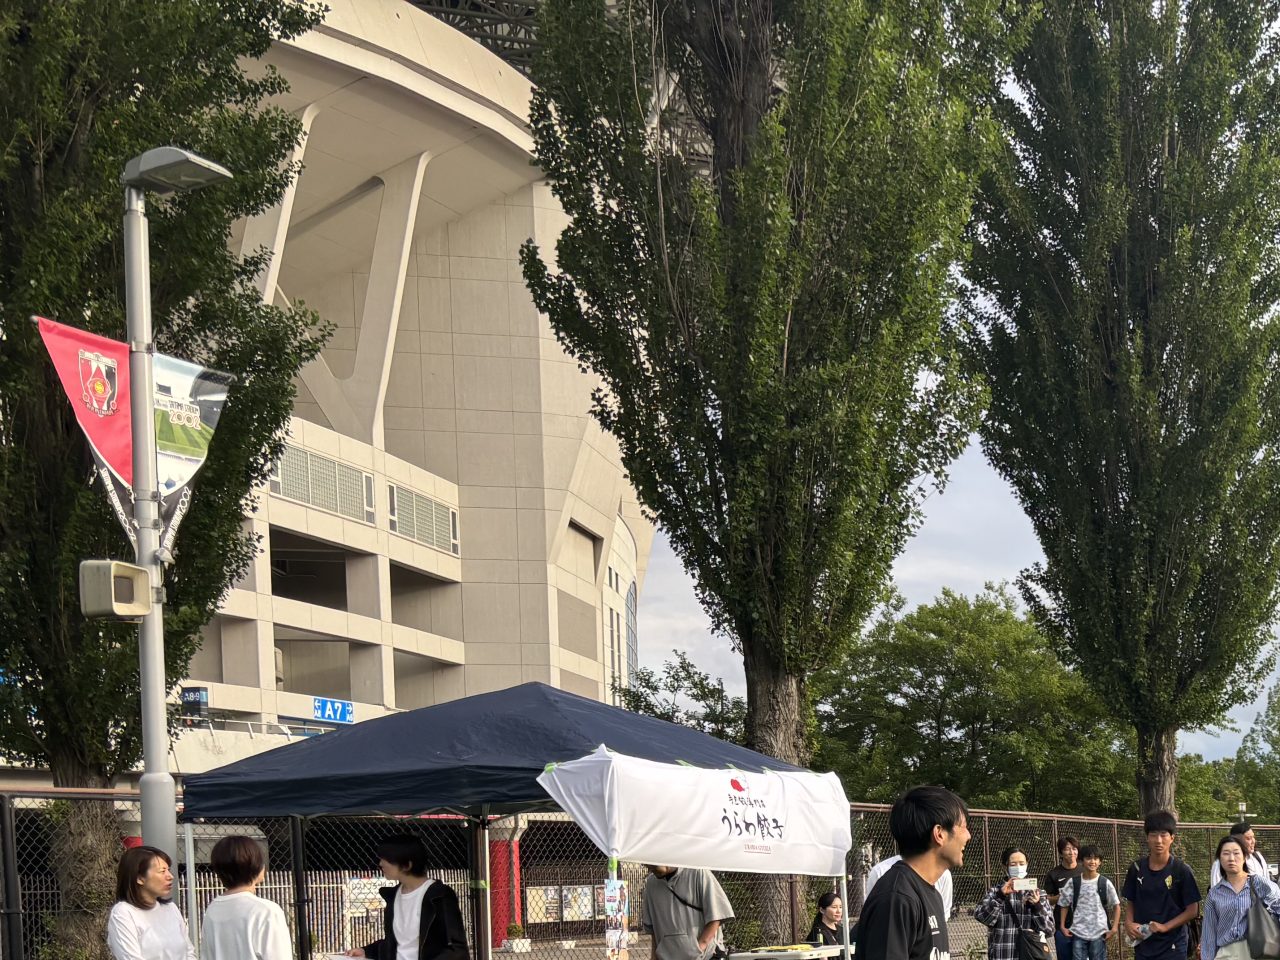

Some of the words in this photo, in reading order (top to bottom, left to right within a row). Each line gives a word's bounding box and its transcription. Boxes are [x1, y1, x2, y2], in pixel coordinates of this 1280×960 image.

[170, 411, 201, 430] 2002
[177, 486, 191, 513] 2002
[325, 701, 342, 720] A7
[721, 808, 784, 841] うらわ餃子
